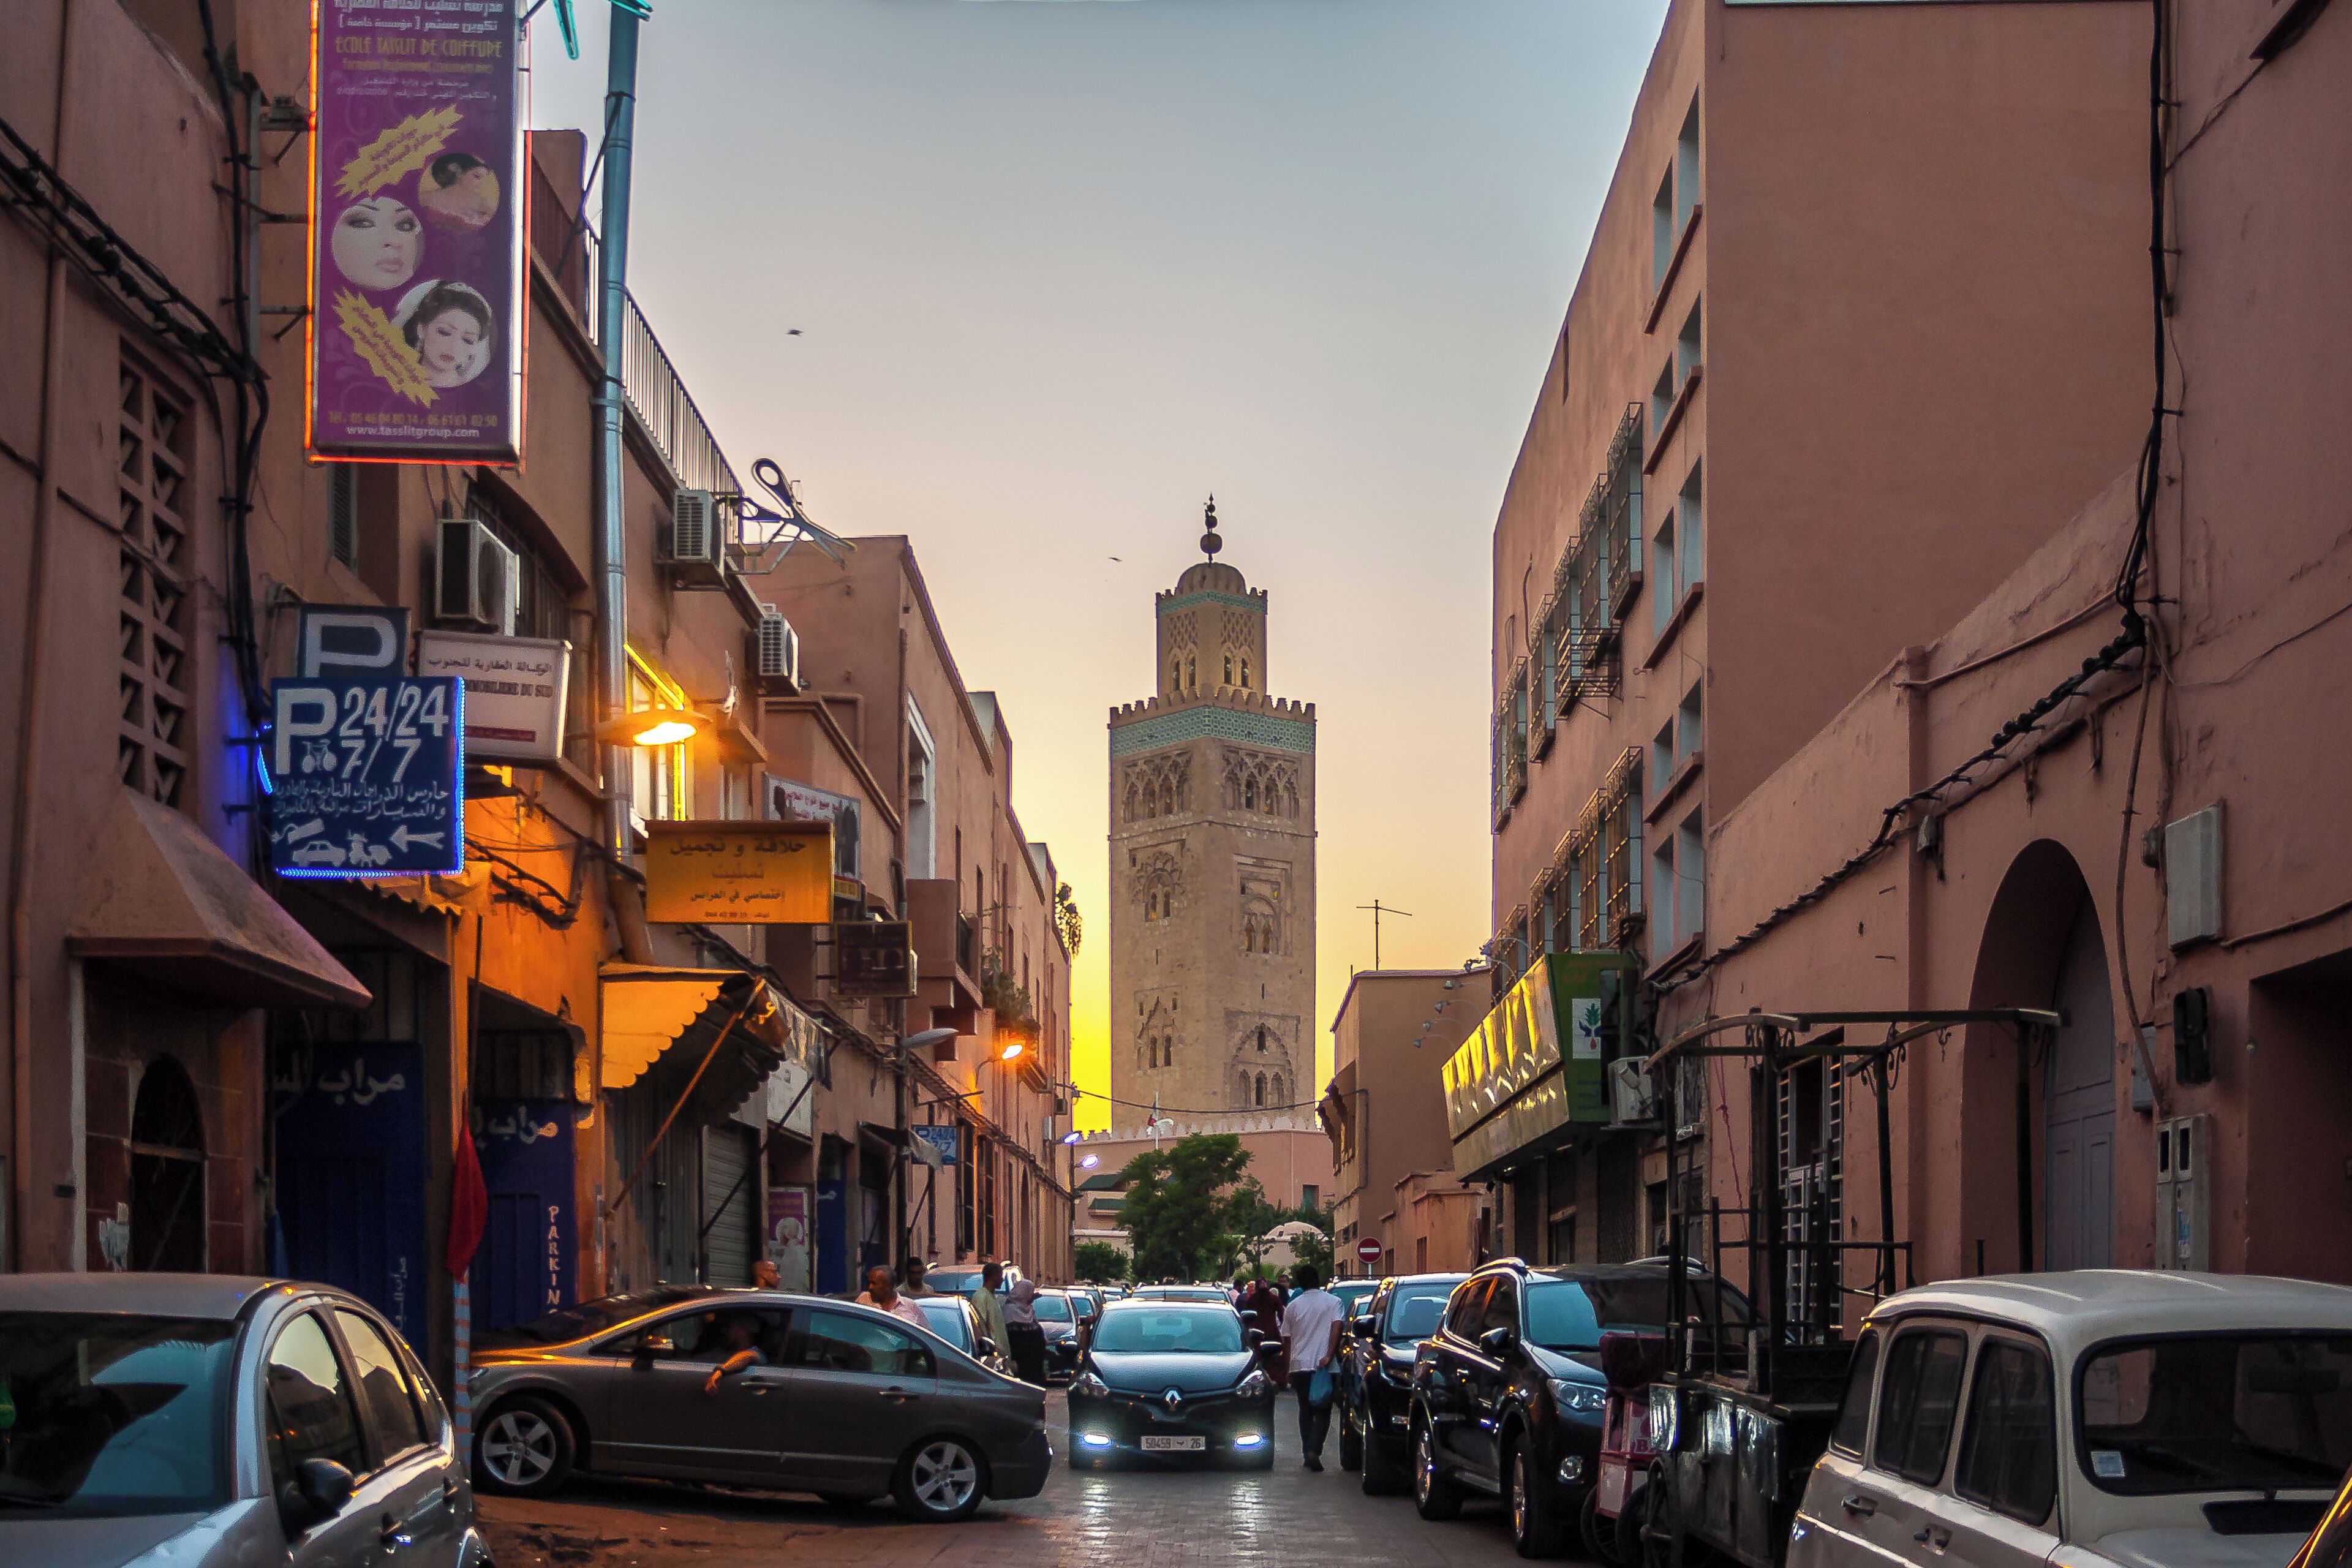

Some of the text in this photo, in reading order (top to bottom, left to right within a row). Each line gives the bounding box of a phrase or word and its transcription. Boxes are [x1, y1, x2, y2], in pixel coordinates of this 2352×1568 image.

[335, 36, 372, 54] ECOLE
[420, 39, 437, 56] DE
[442, 39, 503, 58] COIFFURE
[345, 425, 480, 439] www.tasslitgroup.com
[305, 614, 398, 677] P
[276, 688, 337, 775] P
[339, 681, 449, 741] 24/24
[341, 737, 421, 783] 7/7
[669, 837, 806, 858] حلاقة و تجميل
[547, 1205, 562, 1314] PARKIN
